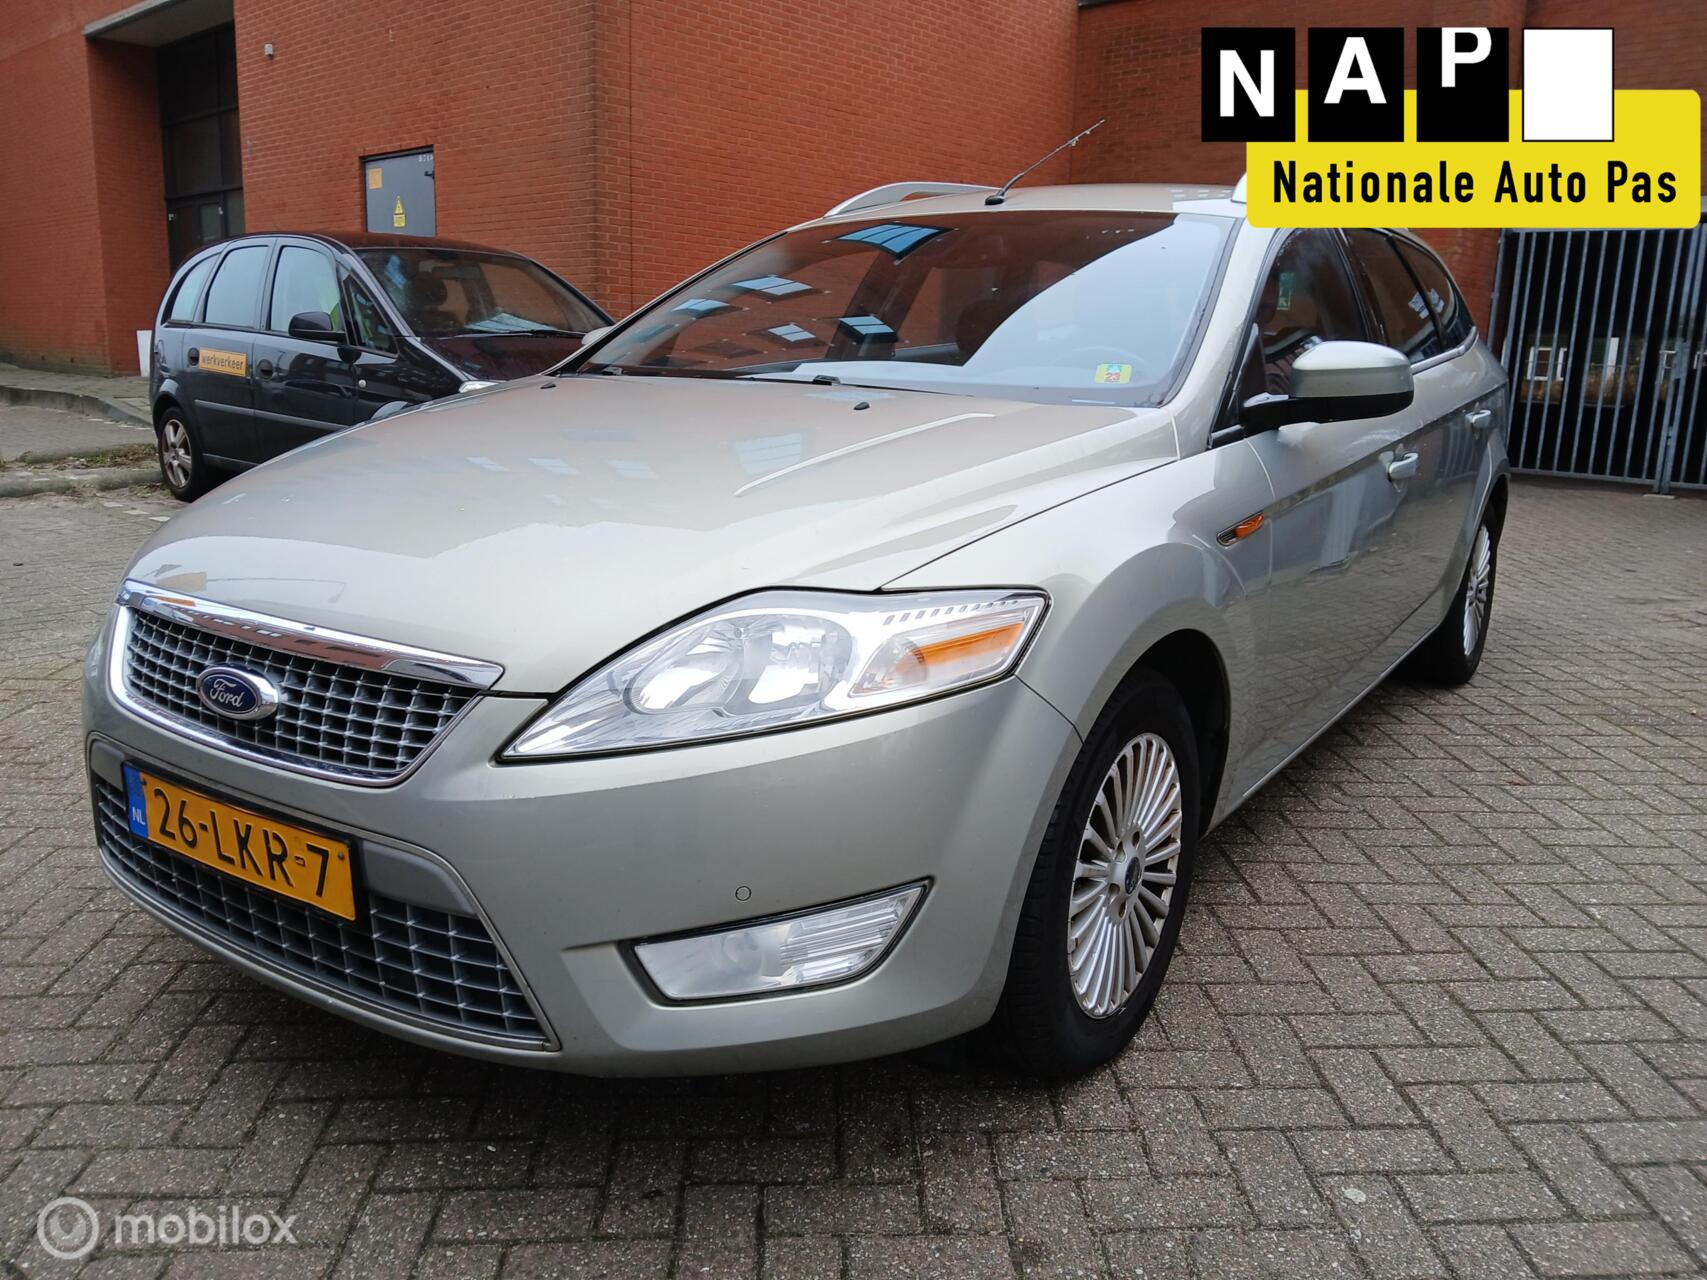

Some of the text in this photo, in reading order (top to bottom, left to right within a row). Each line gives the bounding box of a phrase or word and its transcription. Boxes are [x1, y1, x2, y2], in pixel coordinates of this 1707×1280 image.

[200, 353, 244, 371] werkverkeer
[209, 678, 246, 708] Ford
[131, 806, 146, 826] NL
[153, 786, 331, 897] 26-LKR-7
